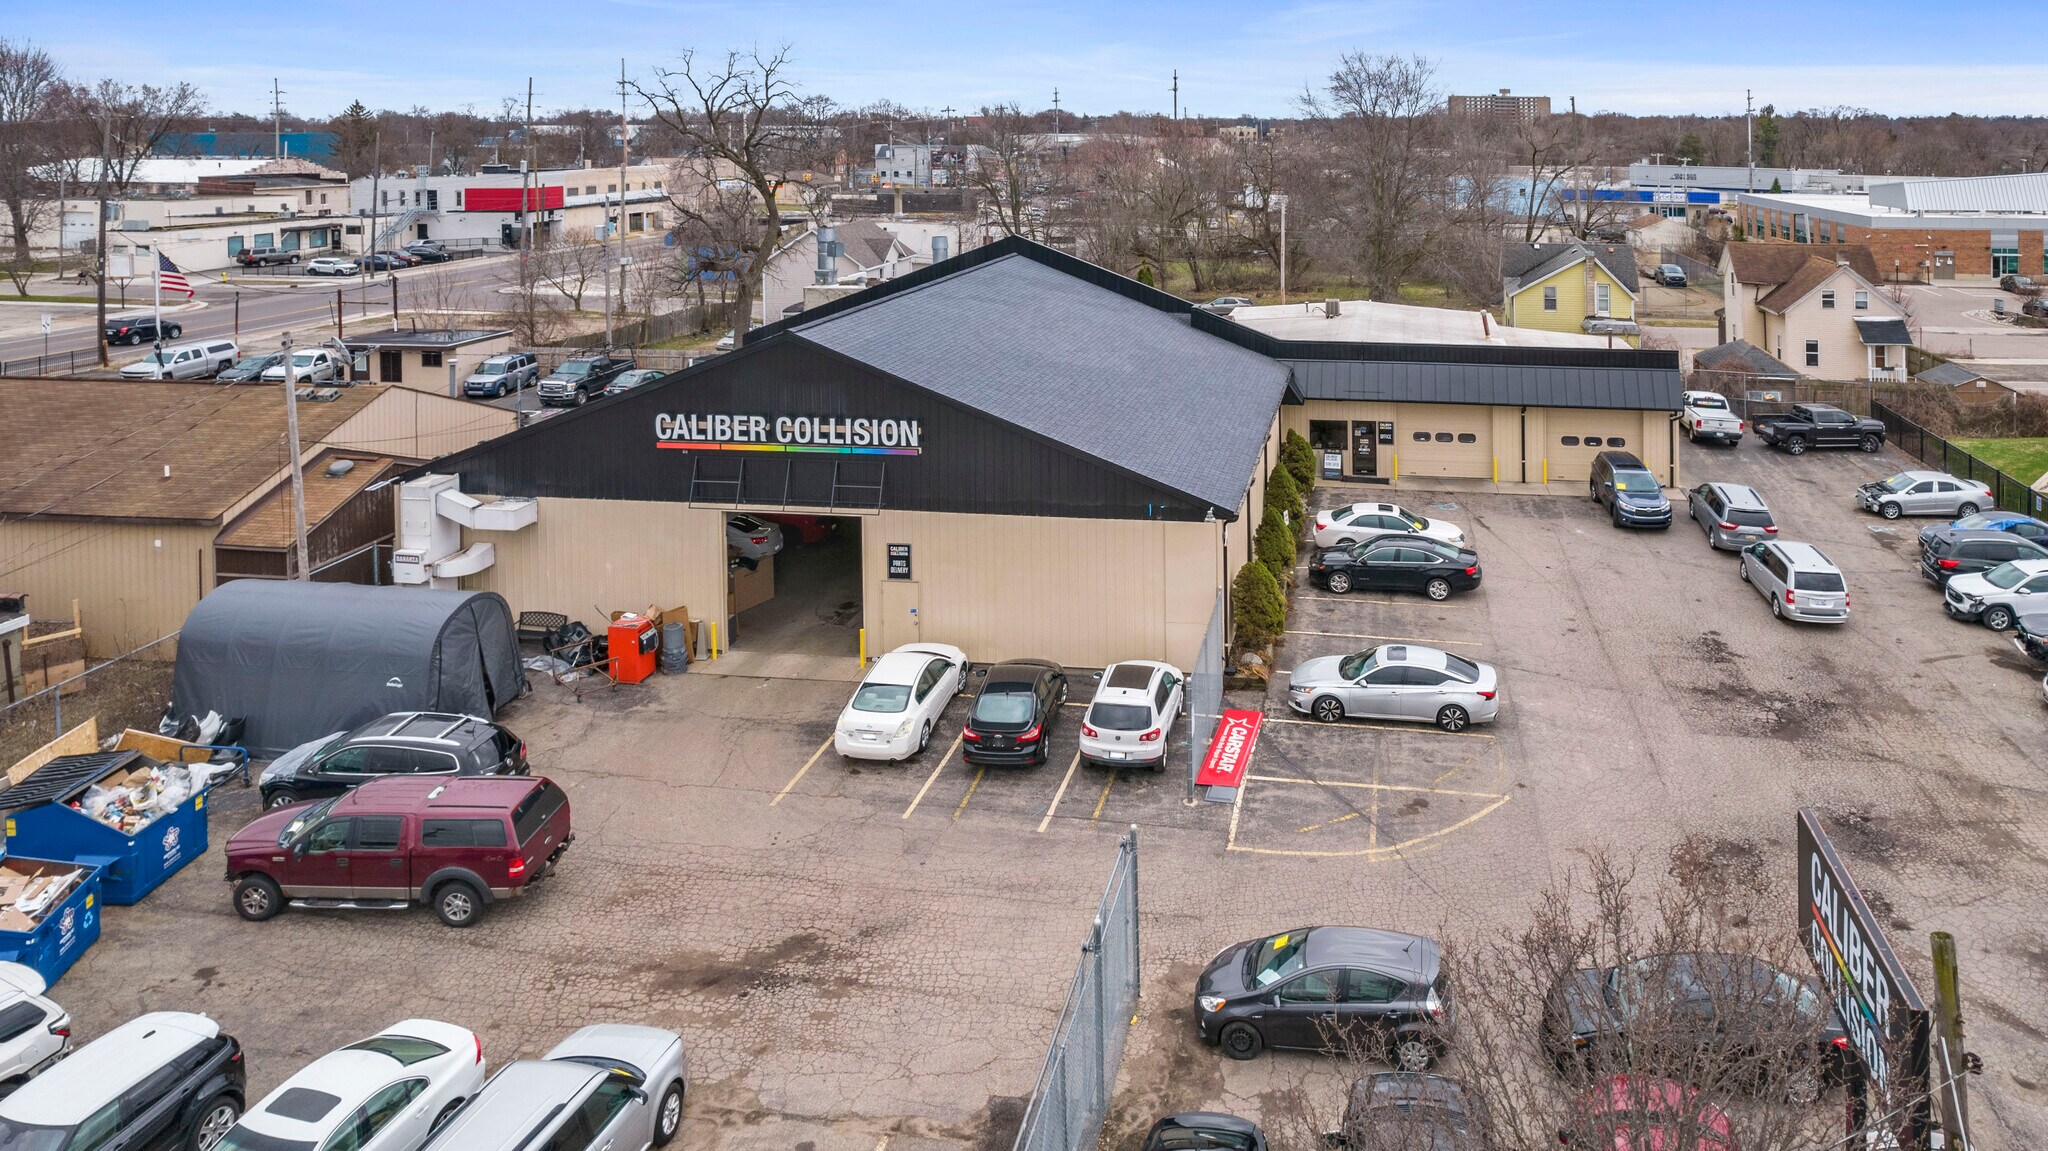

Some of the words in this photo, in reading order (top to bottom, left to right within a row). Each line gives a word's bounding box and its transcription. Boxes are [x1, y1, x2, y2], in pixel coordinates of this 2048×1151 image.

[655, 413, 767, 442] CALIBER
[776, 416, 918, 446] COLLISION
[1216, 726, 1248, 773] CARSTAR
[1811, 851, 1891, 1040] CALIBER
